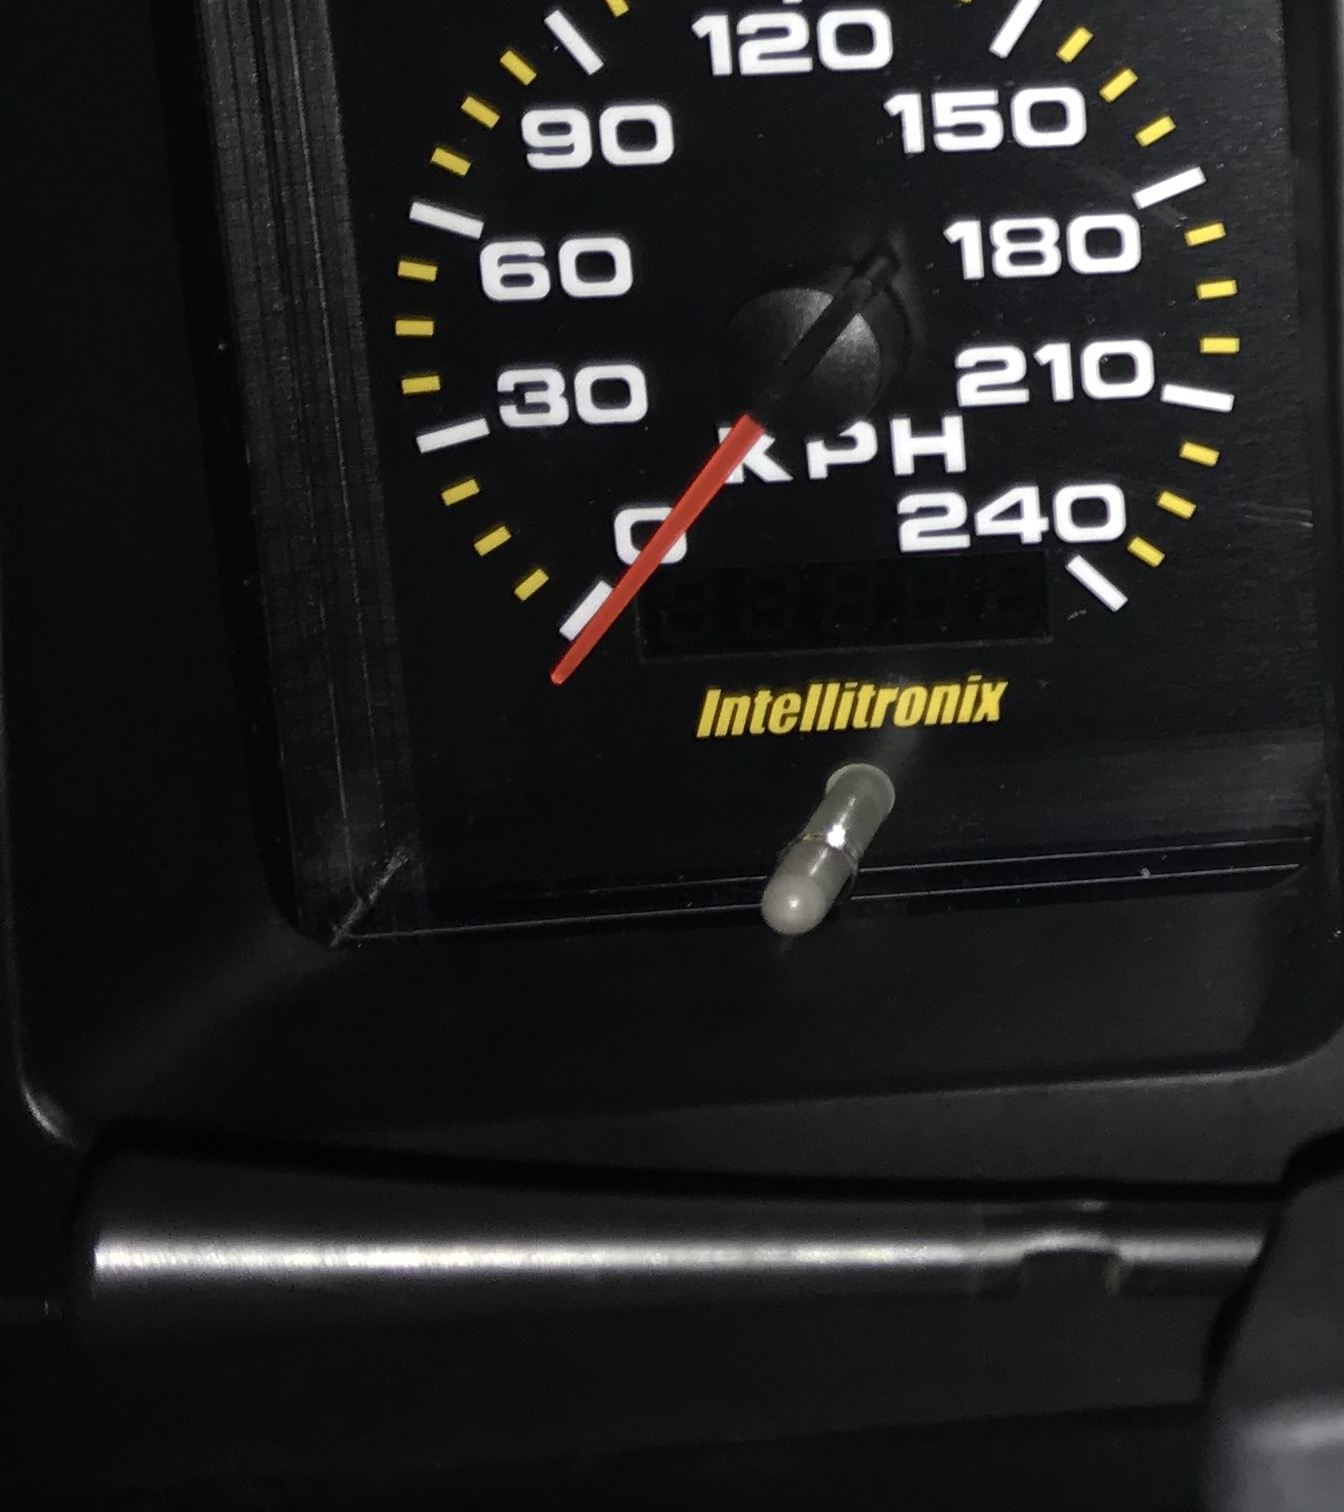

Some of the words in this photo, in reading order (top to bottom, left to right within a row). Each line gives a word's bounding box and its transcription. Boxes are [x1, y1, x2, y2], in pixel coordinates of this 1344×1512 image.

[691, 8, 894, 76] 120
[521, 103, 675, 170] 90
[883, 86, 1087, 154] 150
[479, 236, 633, 301] 60
[943, 212, 1142, 280] 180
[497, 364, 648, 428] 30
[955, 338, 1155, 407] 210
[718, 415, 967, 484] KPH
[614, 506, 688, 565] 0
[897, 483, 1127, 552] 240
[696, 675, 1009, 738] Intellitronix
